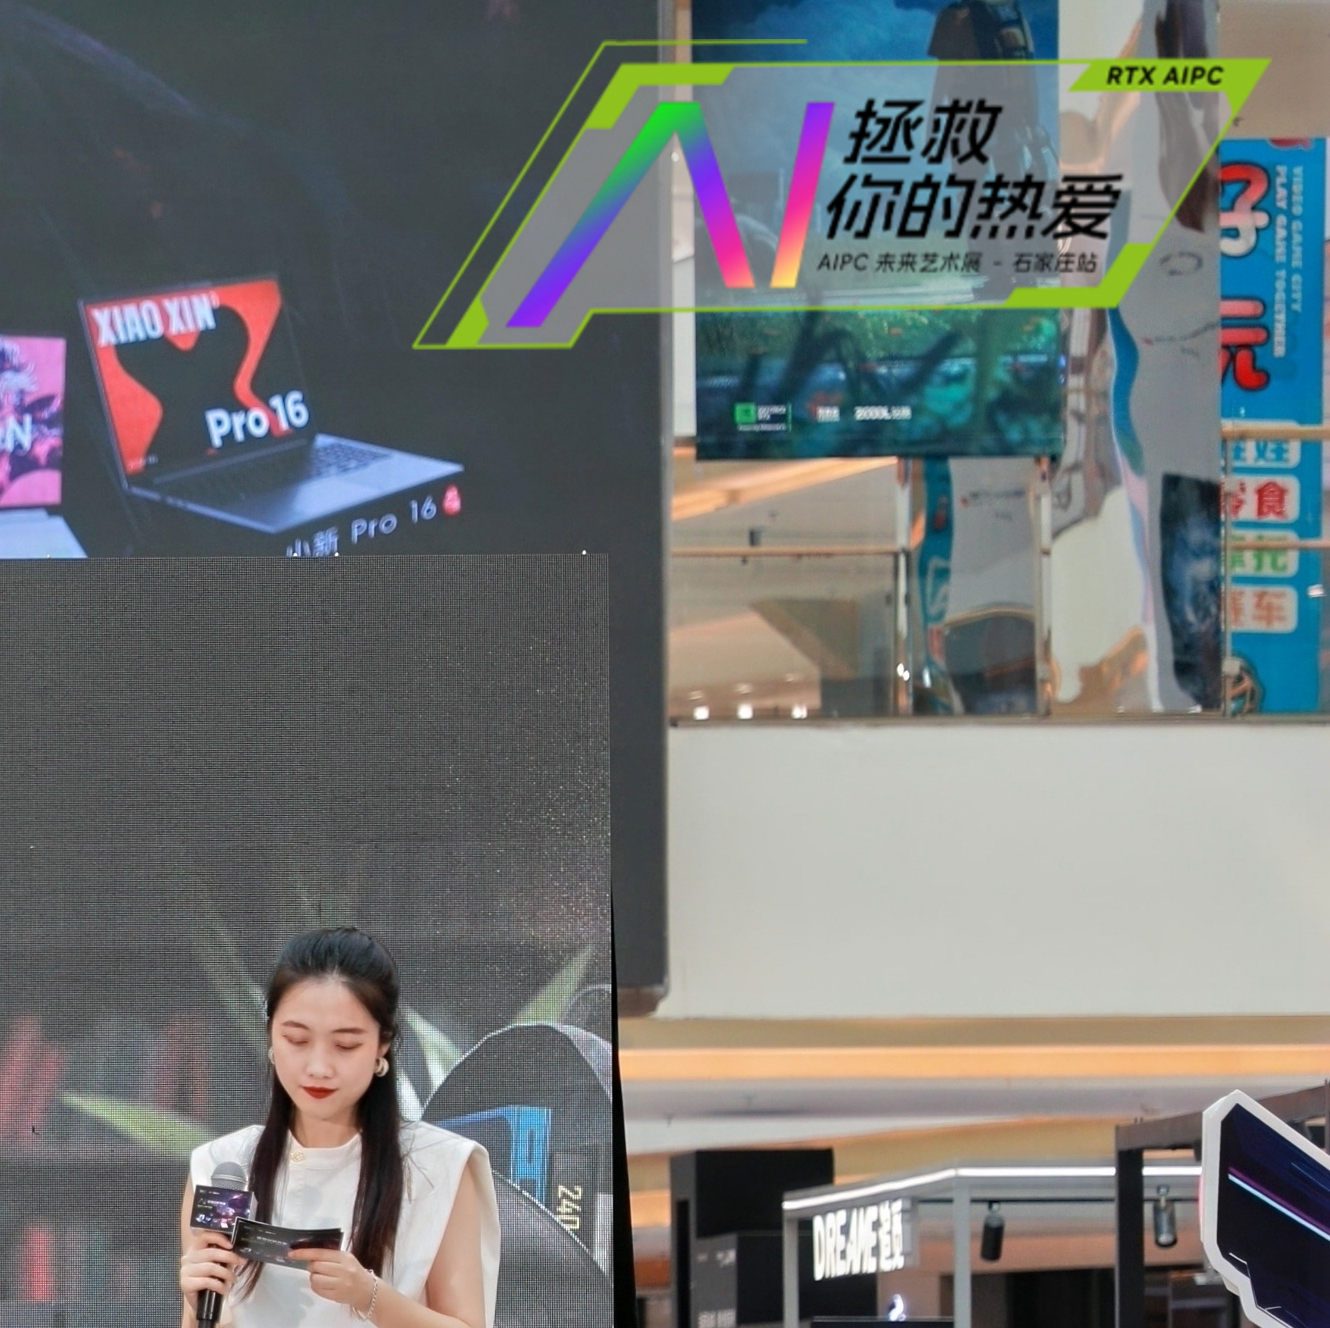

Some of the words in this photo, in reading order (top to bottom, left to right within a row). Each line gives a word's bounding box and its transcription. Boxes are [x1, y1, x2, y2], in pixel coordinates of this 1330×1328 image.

[93, 303, 164, 347] XIAO
[166, 294, 217, 334] XIN
[205, 407, 269, 449] Pro
[269, 391, 309, 430] 16
[351, 512, 397, 543] Pro
[410, 496, 437, 524] 16
[813, 1204, 878, 1281] DREAME
